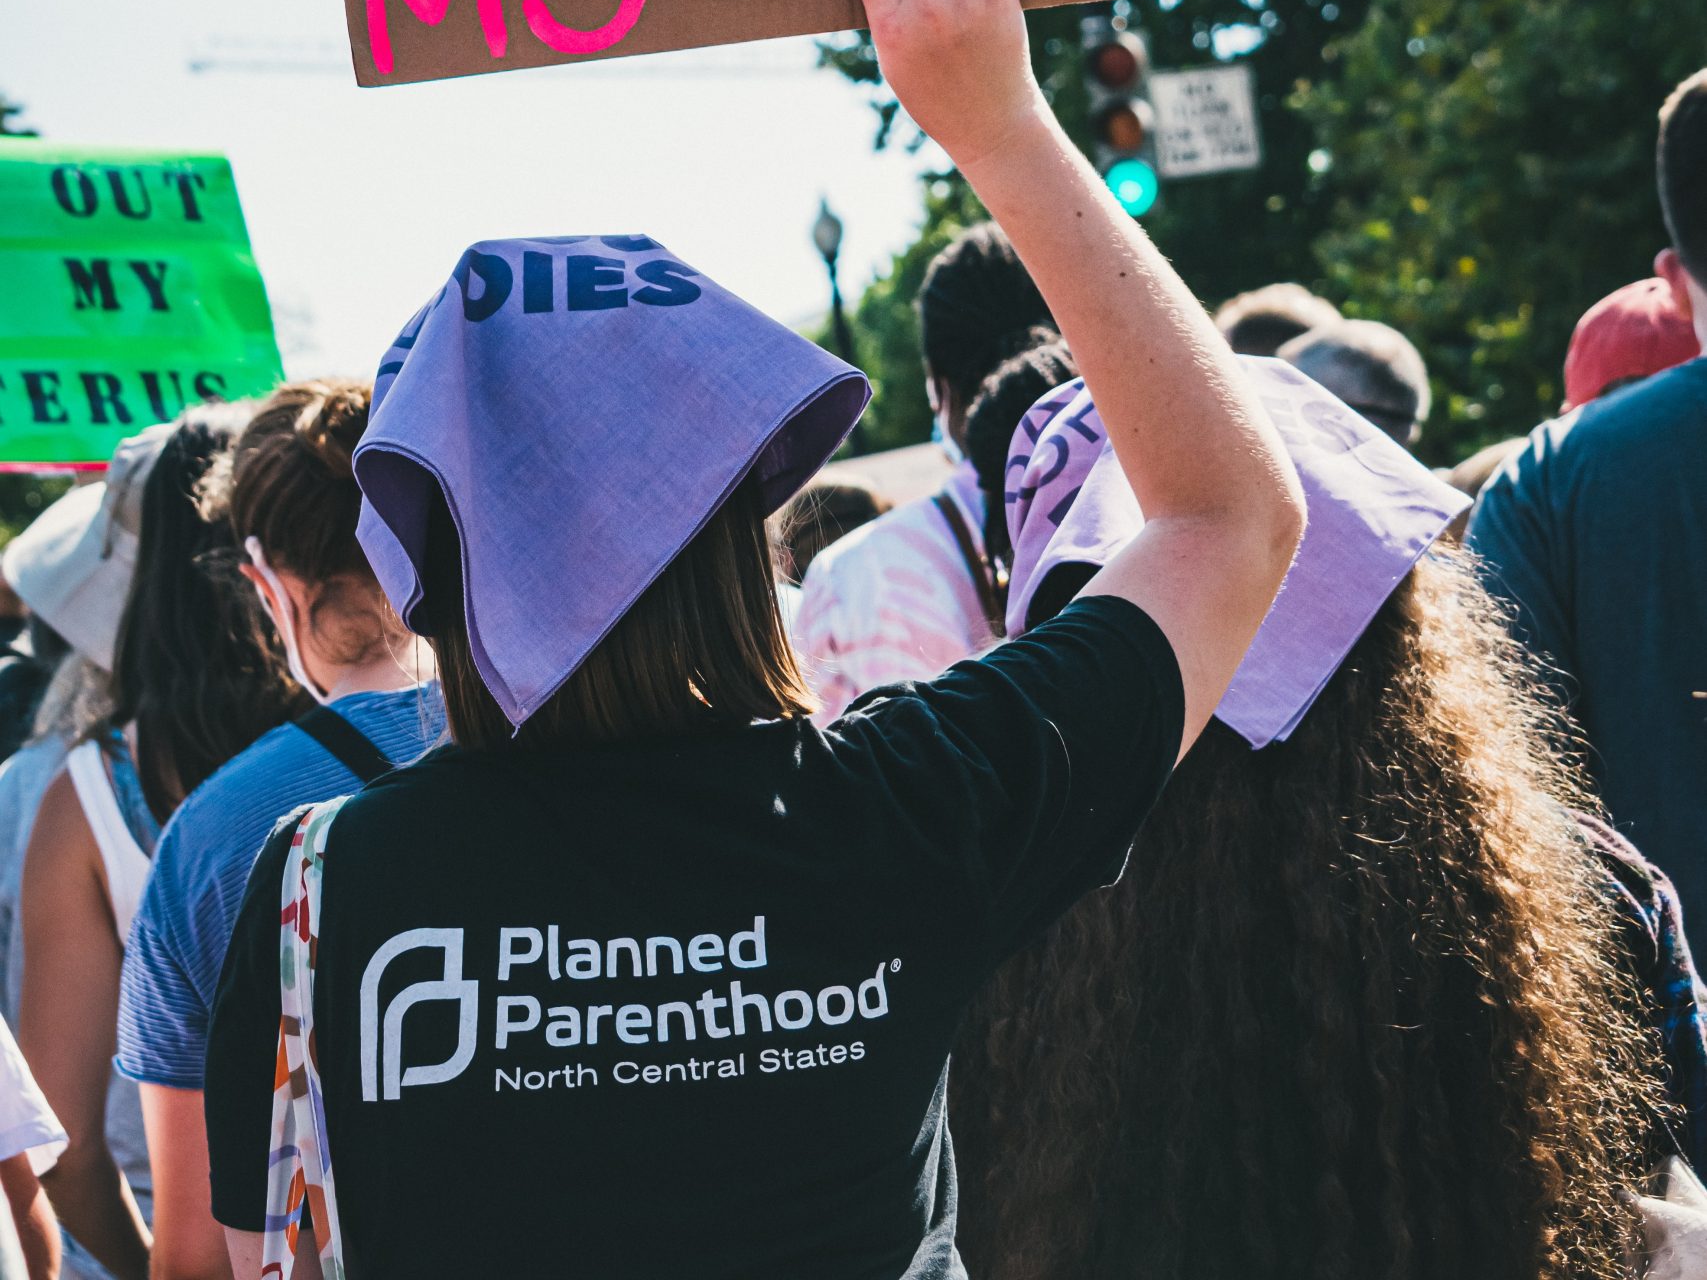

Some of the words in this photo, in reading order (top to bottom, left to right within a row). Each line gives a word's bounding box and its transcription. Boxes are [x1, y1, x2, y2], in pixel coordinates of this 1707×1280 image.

[51, 166, 206, 223] OUT
[62, 256, 171, 312] MY
[0, 370, 227, 424] ERUS
[497, 915, 768, 982] Planned
[495, 1062, 598, 1092] North
[612, 1052, 746, 1085] Central
[758, 1040, 866, 1074] States
